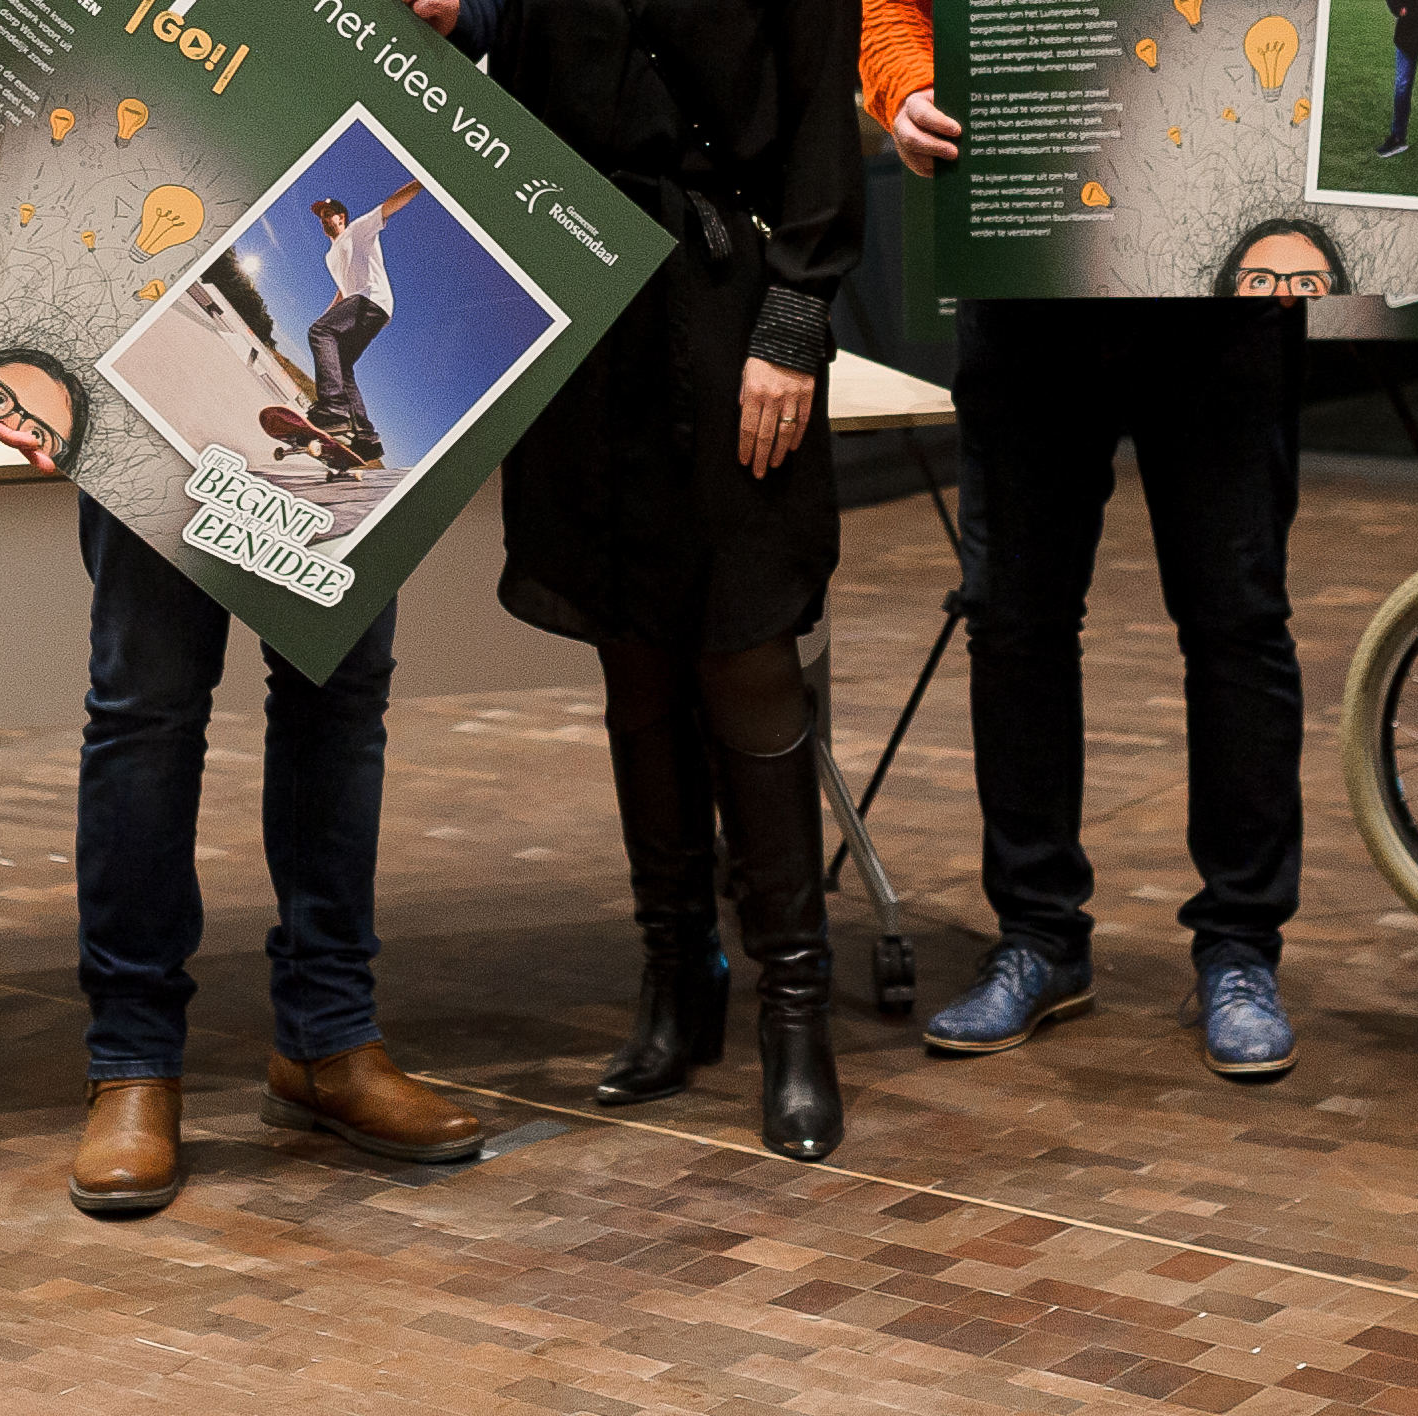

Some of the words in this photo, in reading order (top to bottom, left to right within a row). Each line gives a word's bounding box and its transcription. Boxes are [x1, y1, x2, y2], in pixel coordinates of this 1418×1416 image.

[0, 8, 21, 27] dorp
[19, 22, 54, 56] Wouwse
[38, 20, 62, 43] voort
[58, 39, 73, 53] uit
[49, 10, 75, 35] kwam
[373, 37, 448, 113] idee
[451, 106, 511, 169] van
[548, 202, 619, 267] Roosendaal
[566, 205, 600, 237] Gemeente
[194, 466, 325, 538] BEGINT
[194, 513, 269, 560] EEN
[264, 547, 345, 597] IDEE
